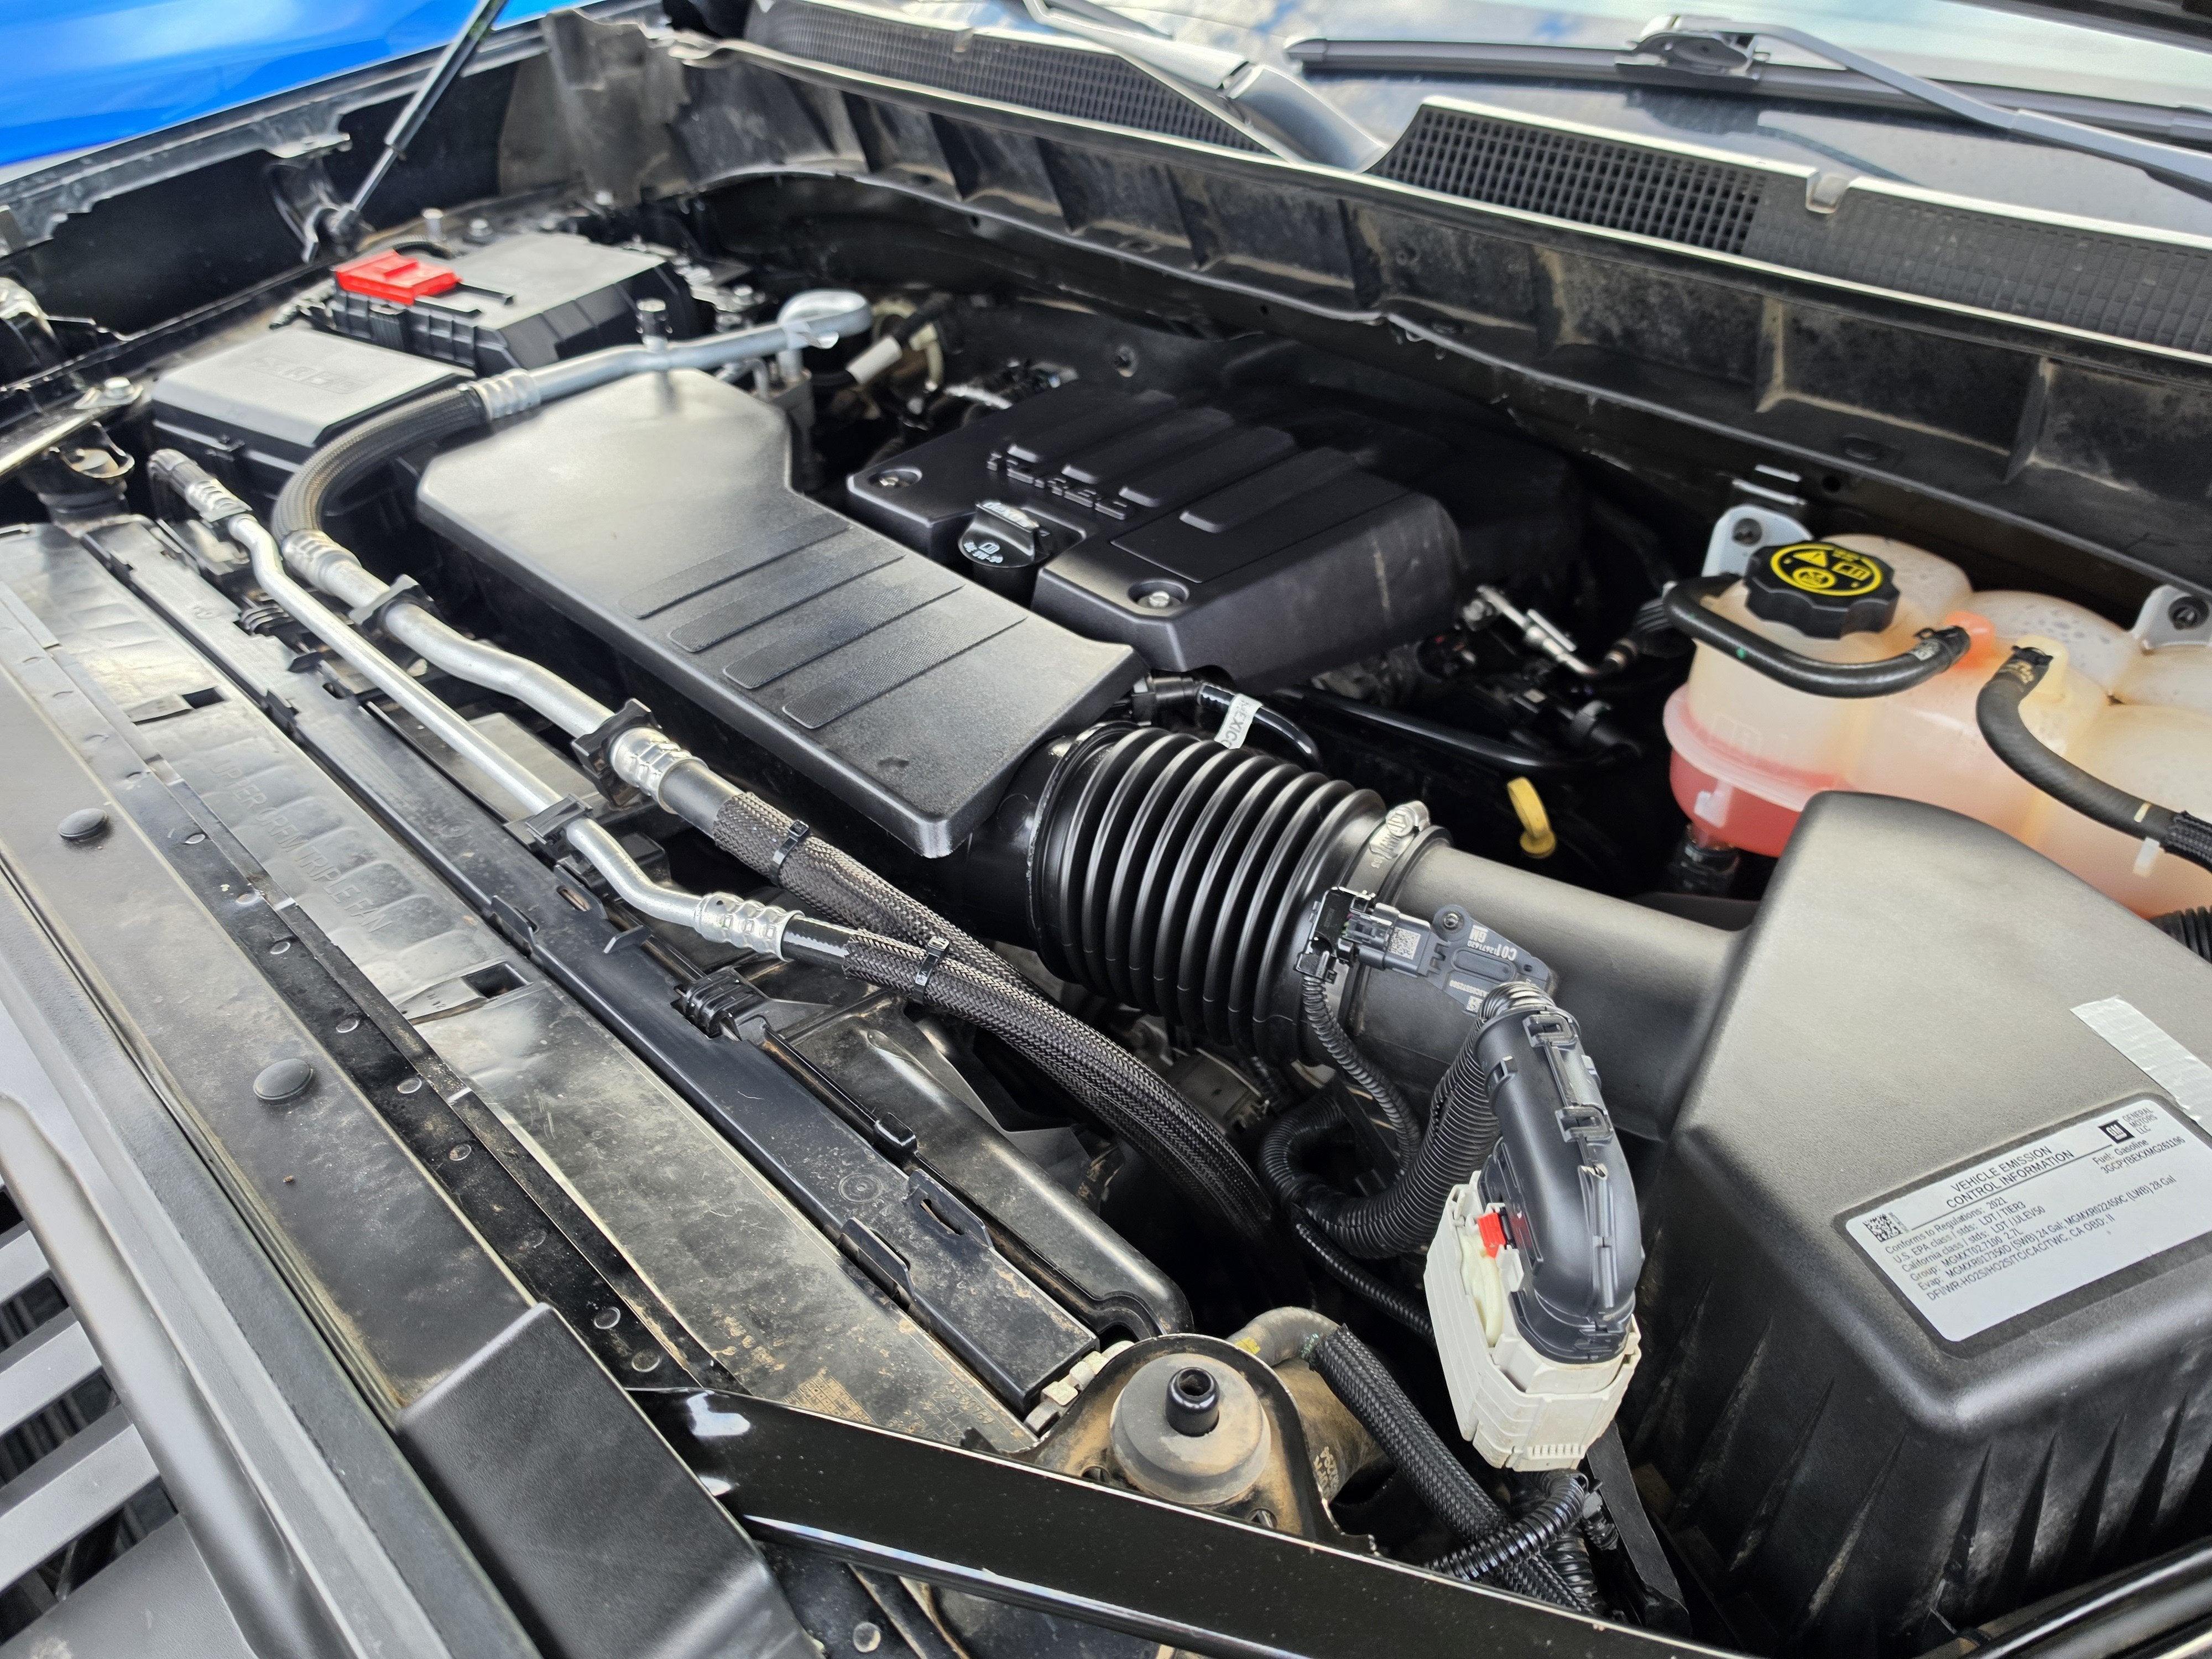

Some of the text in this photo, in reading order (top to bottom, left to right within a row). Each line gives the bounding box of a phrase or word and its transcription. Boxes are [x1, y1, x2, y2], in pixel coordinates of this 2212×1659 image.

[295, 846, 361, 904] TRIPLE
[344, 897, 394, 933] FAN
[1469, 926, 1488, 943] GM
[2122, 1108, 2153, 1123] GENERAL
[2129, 1114, 2158, 1128] MOTORS
[2136, 1125, 2151, 1135] LLC
[1950, 1146, 2053, 1192] VEHICLE EMISSION
[2092, 1139, 2149, 1165] Fuel: Gasoline
[2100, 1136, 2185, 1174] 3GCPYBEKXMG261196
[1947, 1150, 2075, 1208] CONTROL INFORMATION
[1885, 1234, 1926, 1254] Conforms
[1934, 1207, 1985, 1232] Regulations:
[1986, 1197, 2007, 1209] 2021
[1893, 1252, 1913, 1263] U.S.
[1911, 1244, 1931, 1255] EPA
[1931, 1234, 1952, 1248] class
[1957, 1223, 1978, 1236] stds:
[1979, 1213, 1997, 1225] LDT
[2000, 1201, 2026, 1217] TIER3
[1902, 1252, 1942, 1272] California
[1942, 1242, 1964, 1255] class
[1968, 1231, 1990, 1243] stds:
[1990, 1220, 2010, 1233] LDT
[1918, 1277, 1944, 1291] Evap:
[2010, 1233, 2039, 1251] (SWB)
[2036, 1228, 2049, 1238] 24
[2126, 1185, 2154, 1202] (LWB)
[2149, 1181, 2162, 1191] 28
[2160, 1175, 2177, 1186] Gal
[2069, 1227, 2085, 1237] CA
[2083, 1217, 2108, 1232] OBD:
[1910, 1265, 1940, 1281] Group:
[2004, 1228, 2023, 1240] 2.7L
